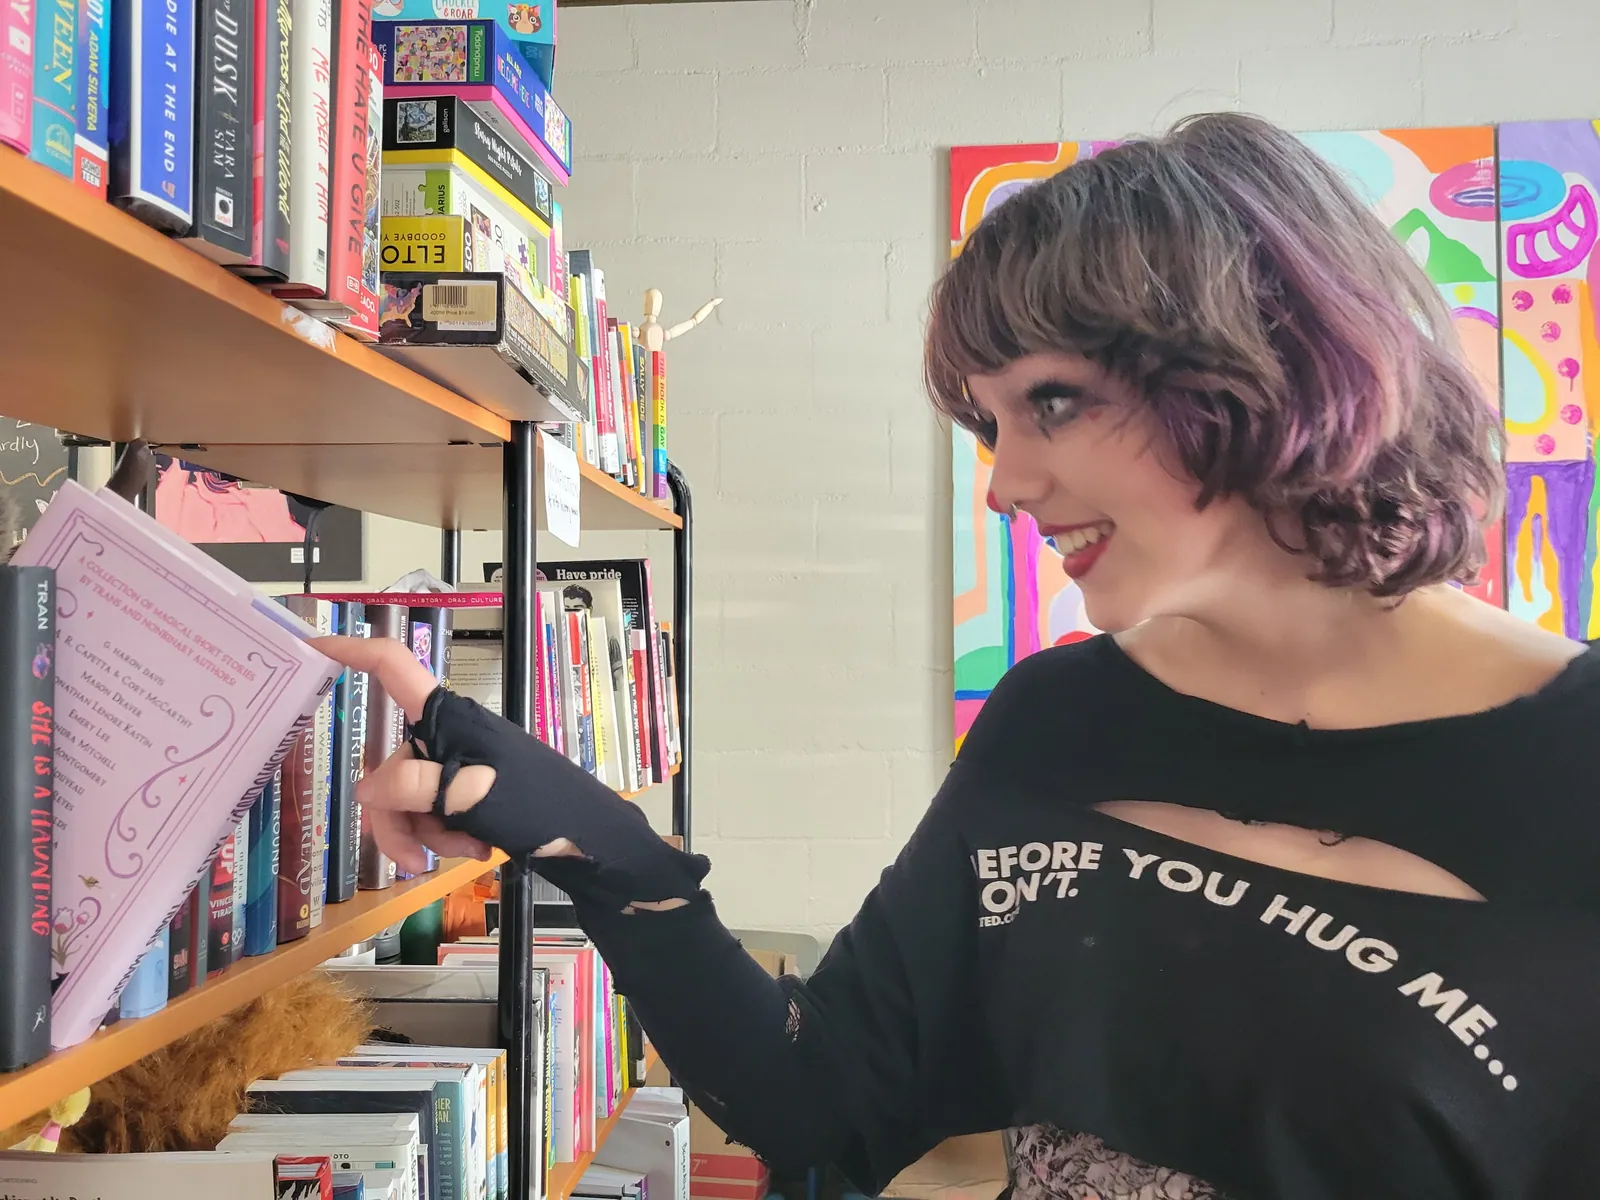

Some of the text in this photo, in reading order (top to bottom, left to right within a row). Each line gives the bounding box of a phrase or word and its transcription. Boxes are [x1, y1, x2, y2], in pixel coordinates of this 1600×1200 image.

[450, 8, 474, 19] ROAR
[86, 0, 104, 131] OT ADAM SILVERA
[213, 8, 239, 106] DUSK
[312, 47, 330, 85] ME
[473, 29, 483, 77] mudpuppy
[163, 0, 178, 173] DIE AT THE END
[214, 129, 225, 167] SIM
[312, 92, 329, 155] MYSELF
[348, 0, 372, 255] THE HATE U GIVE
[224, 128, 237, 179] TARA
[279, 150, 291, 224] World
[315, 182, 329, 224] HIM
[381, 245, 445, 264] ELTO
[394, 233, 446, 241] GOODBYE
[464, 232, 473, 272] 500
[659, 414, 665, 425] IS
[556, 568, 587, 580] Have
[588, 569, 622, 581] pride
[37, 580, 49, 631] TRAN
[78, 556, 257, 682] A COLLECTION OF MAGICAL SHORT STORIES
[470, 596, 502, 604] CULTURE
[79, 574, 238, 687] BY TRANS AND NONBINARY AUTHORS!
[75, 643, 112, 674] CAPETTA
[113, 670, 120, 678] &
[121, 675, 146, 697] CORY
[112, 647, 143, 671] HARON
[142, 667, 165, 687] DAVIS
[54, 676, 154, 749] ONATHAN LENORE KASTIN
[81, 670, 143, 718] MASON DEAVER
[68, 709, 112, 744] EMERY LEE
[350, 705, 362, 783] GIRLS
[77, 739, 117, 771] MITCHELL
[31, 700, 53, 936] SHE IS A HAUNTING
[296, 727, 313, 895] RED THREAD
[221, 843, 233, 875] UP
[271, 809, 281, 875] ROUND
[981, 871, 1079, 913] ON'T.
[971, 841, 1518, 1092] EFORE YOU HUG ME...
